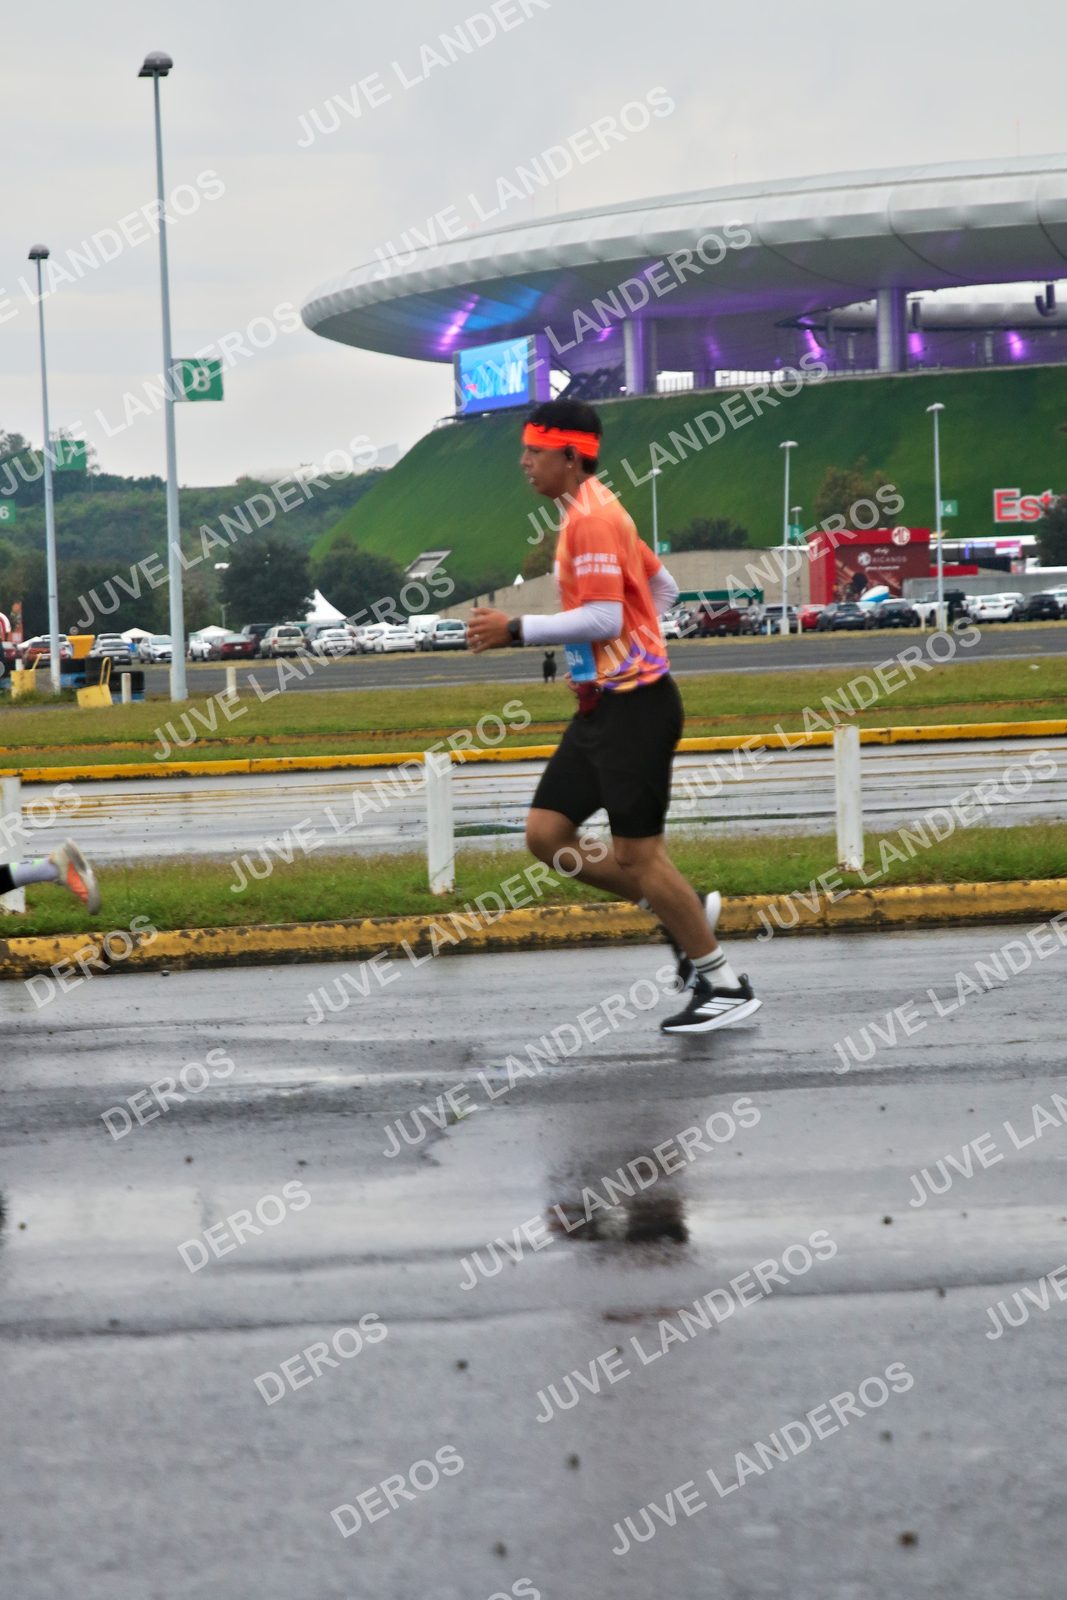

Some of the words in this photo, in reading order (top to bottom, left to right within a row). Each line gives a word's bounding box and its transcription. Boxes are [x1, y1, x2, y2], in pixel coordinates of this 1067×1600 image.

[193, 366, 211, 392] 8
[64, 447, 76, 464] 7
[945, 503, 953, 513] 4
